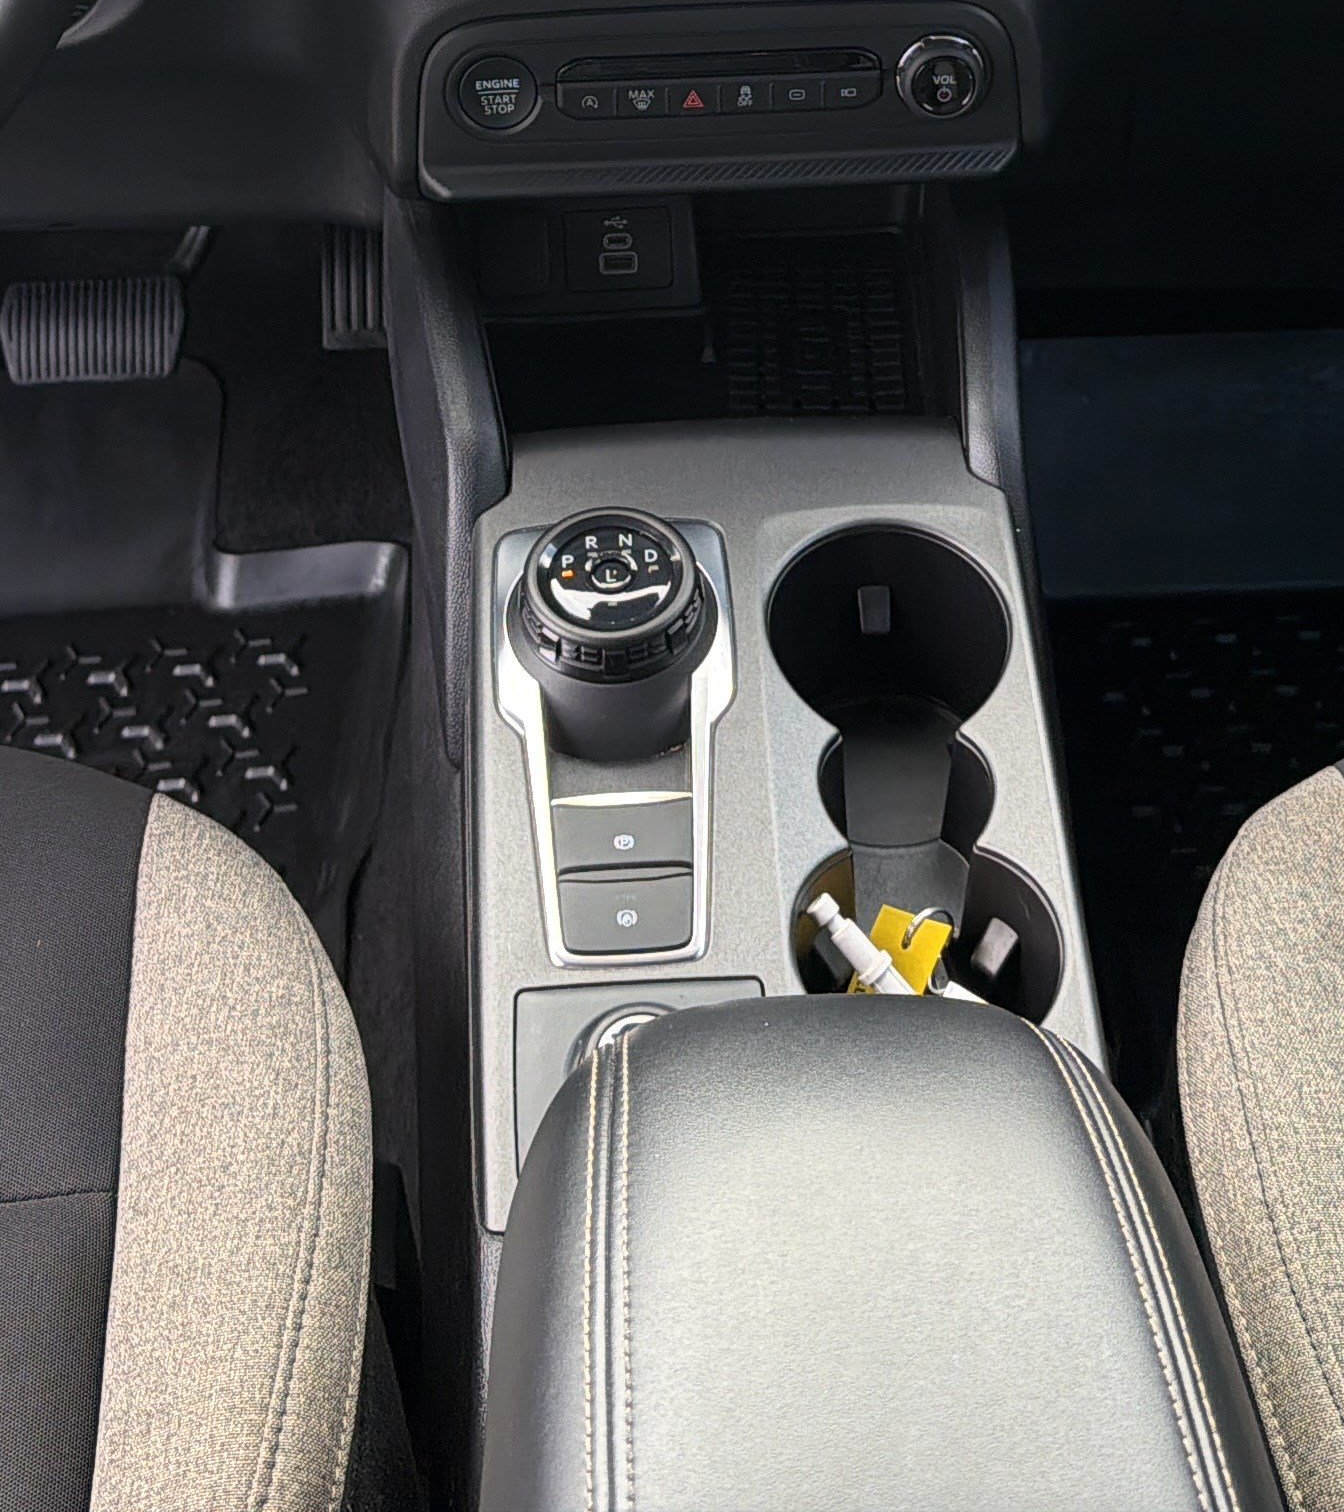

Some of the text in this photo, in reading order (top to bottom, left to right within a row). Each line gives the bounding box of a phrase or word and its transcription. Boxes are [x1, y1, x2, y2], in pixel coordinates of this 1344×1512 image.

[475, 78, 520, 90] ENGINE
[932, 75, 956, 85] VOL
[480, 94, 516, 105] START
[628, 89, 655, 99] MAX
[736, 99, 753, 107] OFF
[484, 104, 515, 116] STOP
[585, 535, 597, 549] R
[618, 533, 633, 547] N
[561, 554, 574, 568] P
[644, 548, 658, 563] D
[605, 569, 615, 583] L
